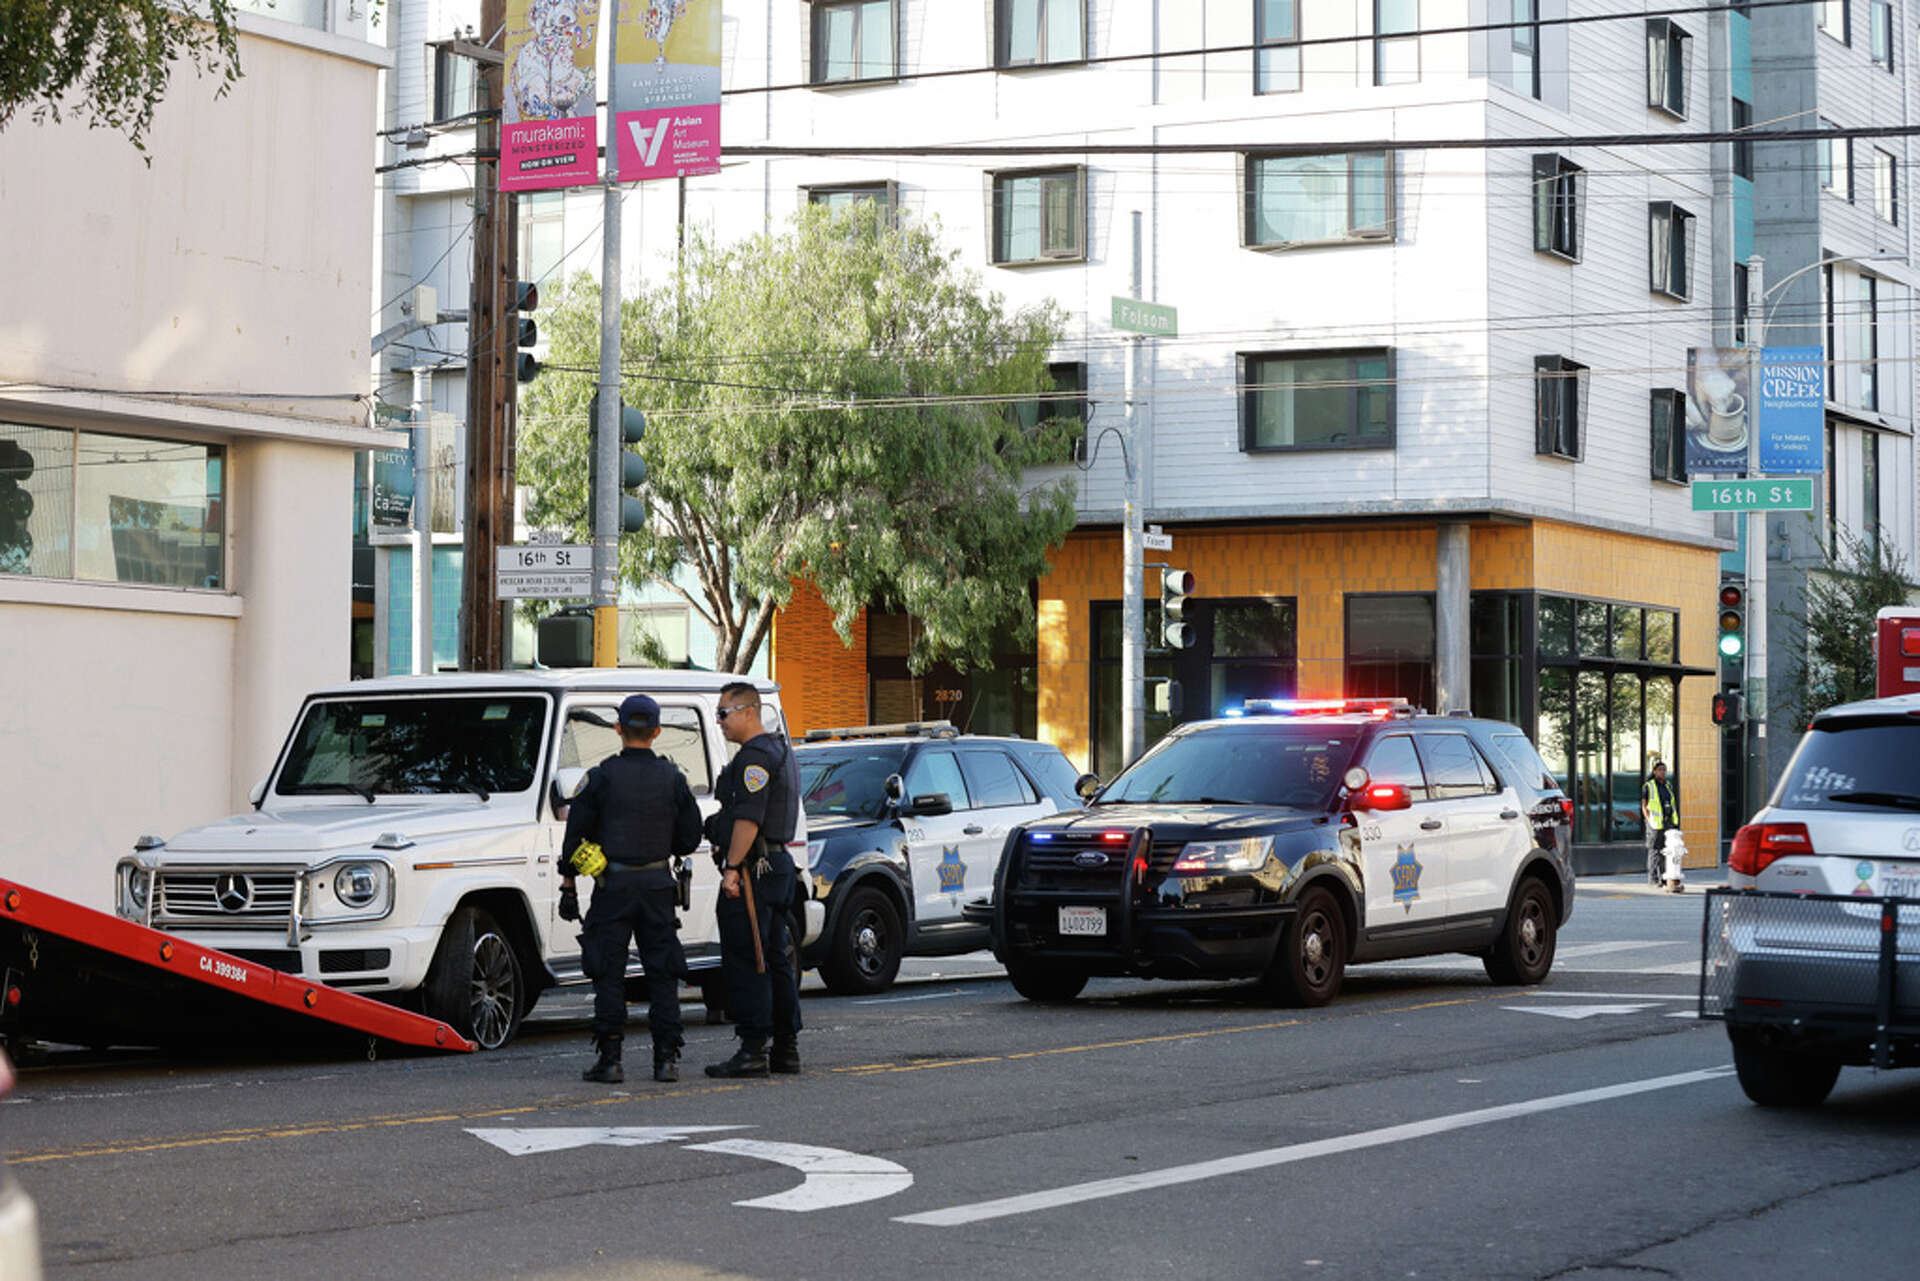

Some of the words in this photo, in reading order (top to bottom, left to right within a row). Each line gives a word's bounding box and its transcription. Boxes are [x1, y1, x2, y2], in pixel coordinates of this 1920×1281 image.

[673, 116, 703, 127] Asian
[512, 121, 585, 145] murakami:
[673, 128, 687, 138] Art
[512, 140, 586, 155] MONSTERIZED
[673, 139, 710, 149] Museum
[520, 160, 540, 169] NOW
[541, 158, 554, 167] ON
[554, 155, 576, 165] VIEW
[1121, 305, 1168, 329] Folsom
[1763, 366, 1820, 382] MISSION
[1763, 378, 1820, 399] CREEK
[1771, 433, 1783, 441] For
[1711, 488, 1757, 504] 16th
[1769, 487, 1793, 503] St
[518, 551, 547, 567] 16th
[555, 551, 571, 566] St
[200, 956, 212, 973] CA
